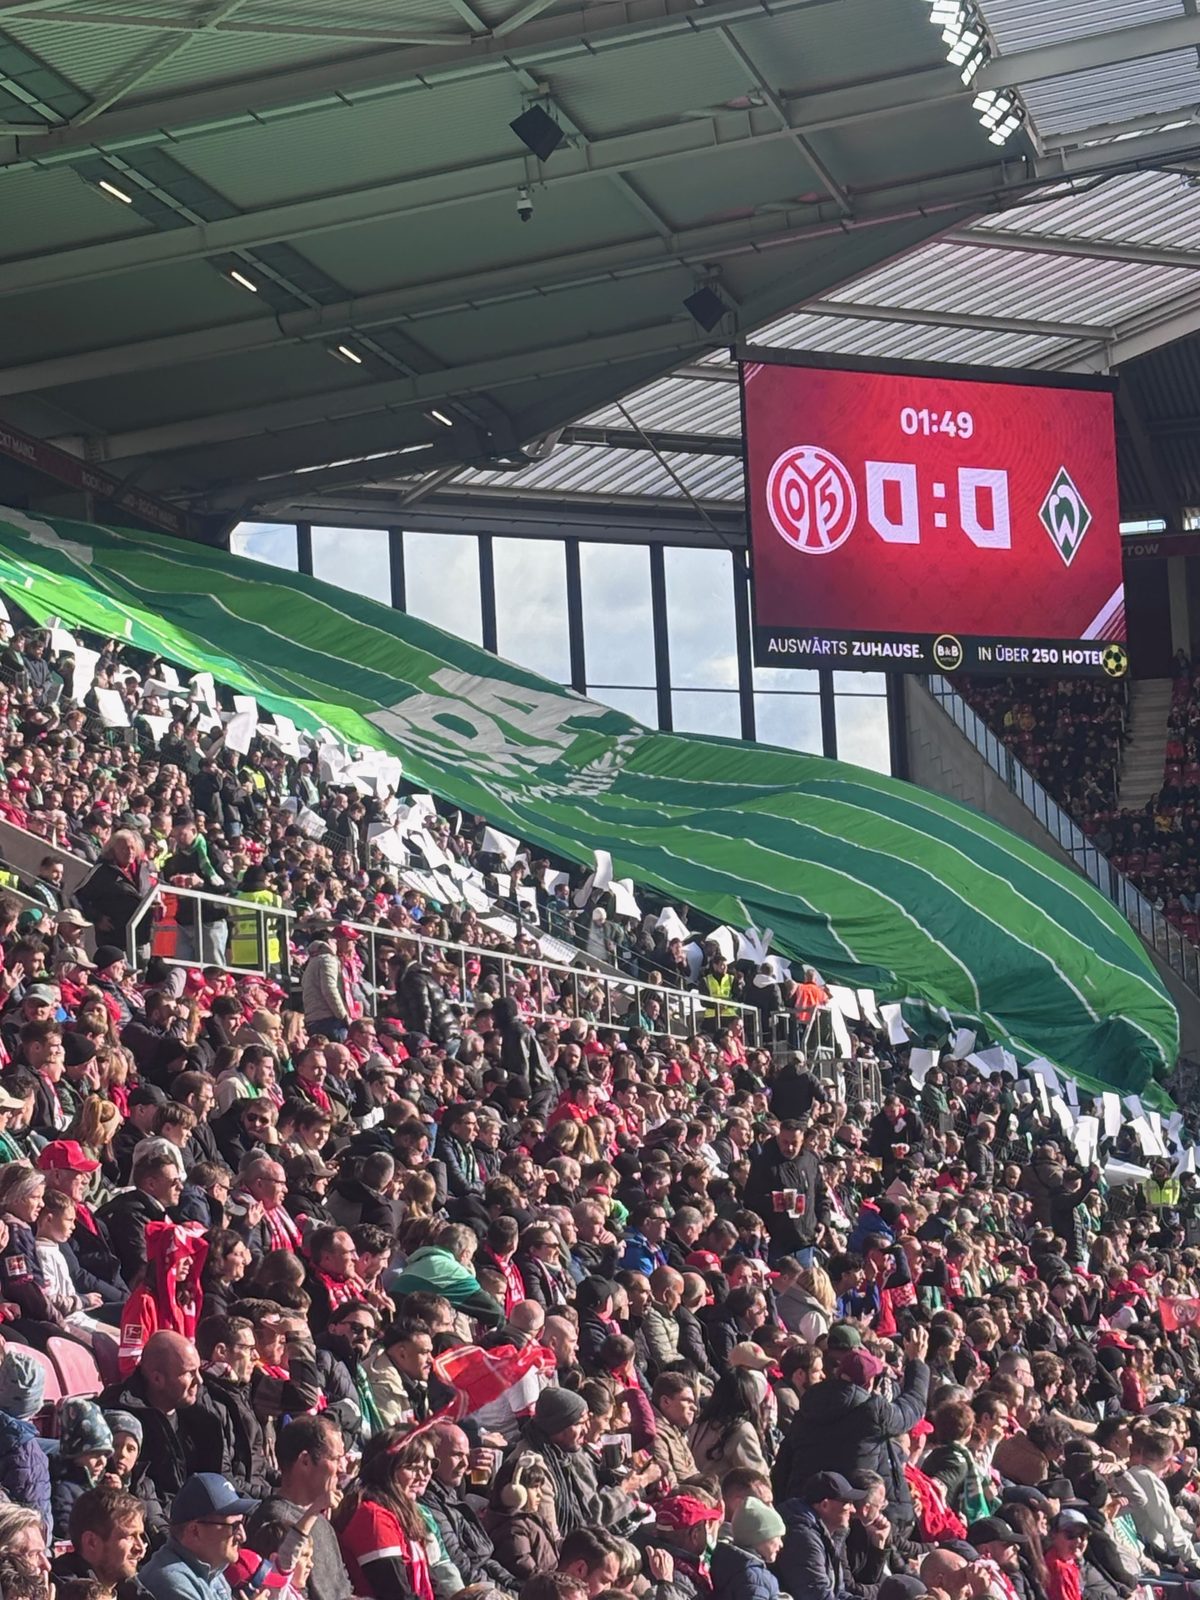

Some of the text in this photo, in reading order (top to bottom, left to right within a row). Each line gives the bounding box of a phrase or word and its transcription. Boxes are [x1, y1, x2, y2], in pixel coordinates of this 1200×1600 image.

[900, 407, 975, 440] 01:49
[768, 636, 924, 659] AUSWÄRTS ZUHAUSE.
[937, 644, 960, 657] B&B
[978, 646, 992, 661] IN
[995, 644, 1029, 663] ÜBER
[1032, 648, 1059, 664] 250
